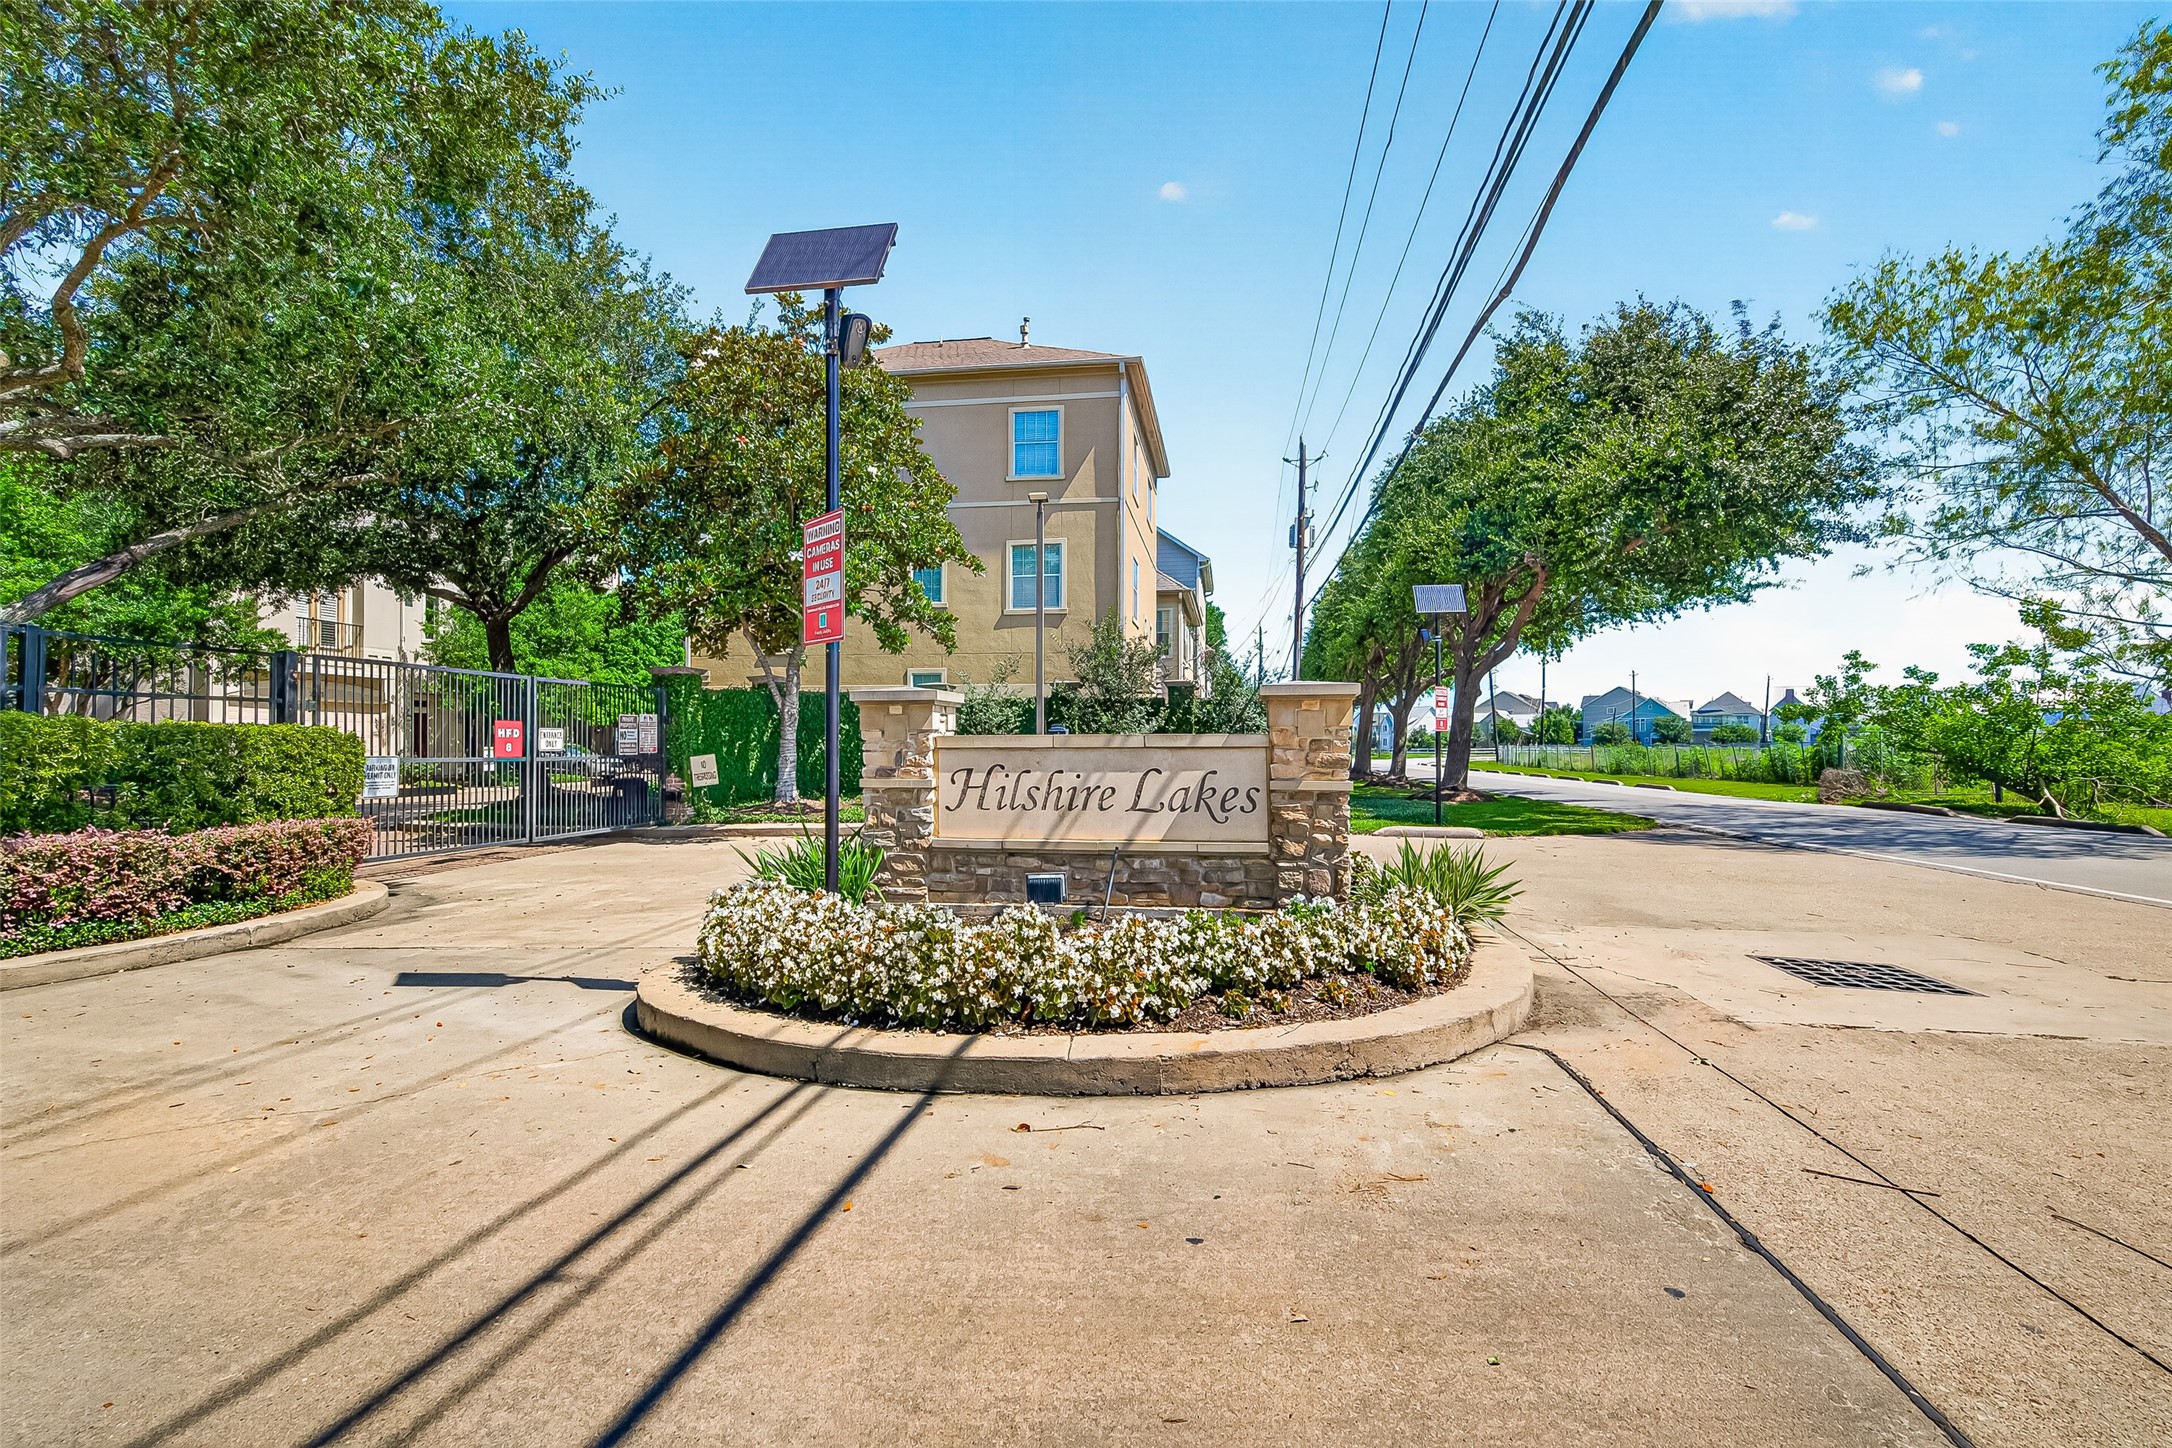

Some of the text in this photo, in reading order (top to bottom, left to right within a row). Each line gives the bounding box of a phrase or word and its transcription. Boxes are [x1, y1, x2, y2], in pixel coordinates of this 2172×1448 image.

[807, 521, 840, 542] WARNING
[807, 539, 840, 559] CAMERAS
[812, 557, 834, 573] IN USE
[815, 578, 830, 591] 24/7
[497, 728, 520, 738] HFD
[540, 731, 563, 740] ENTRANCE
[505, 742, 512, 752] 8
[545, 740, 557, 748] ONLY
[945, 764, 1261, 824] Hilshire Lakes
